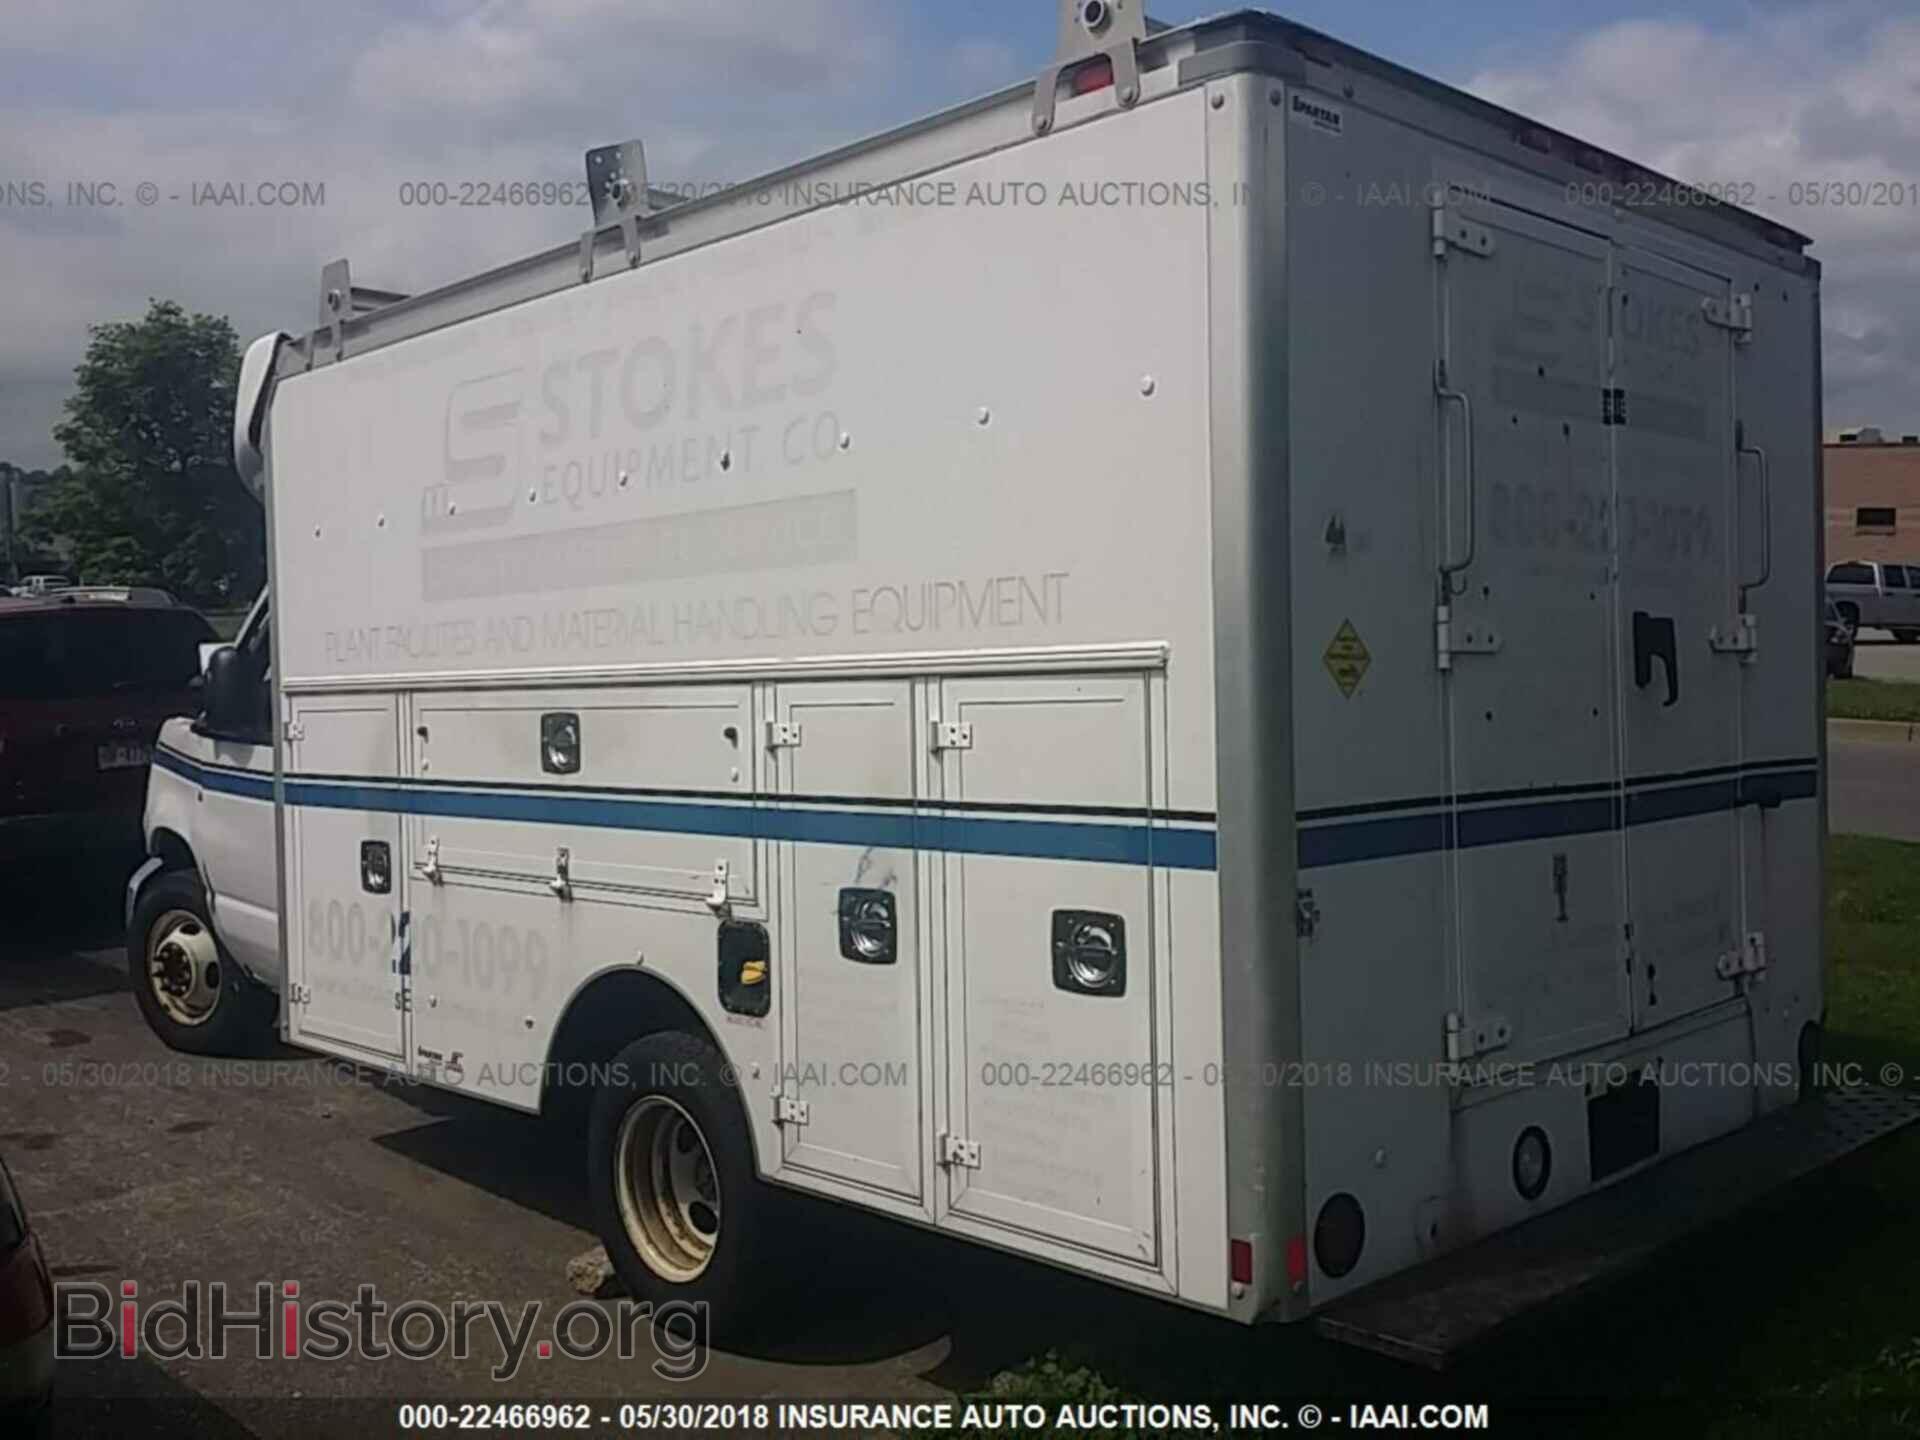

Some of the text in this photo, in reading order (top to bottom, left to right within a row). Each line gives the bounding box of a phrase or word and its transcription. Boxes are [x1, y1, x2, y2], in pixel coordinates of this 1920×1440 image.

[539, 289, 839, 446] STOKES
[541, 424, 761, 512] EQUIPMENT
[484, 616, 536, 654] AND
[544, 607, 666, 650] MATERIAL
[672, 589, 839, 646] HANDLING
[851, 571, 1070, 636] EQUIPMENT
